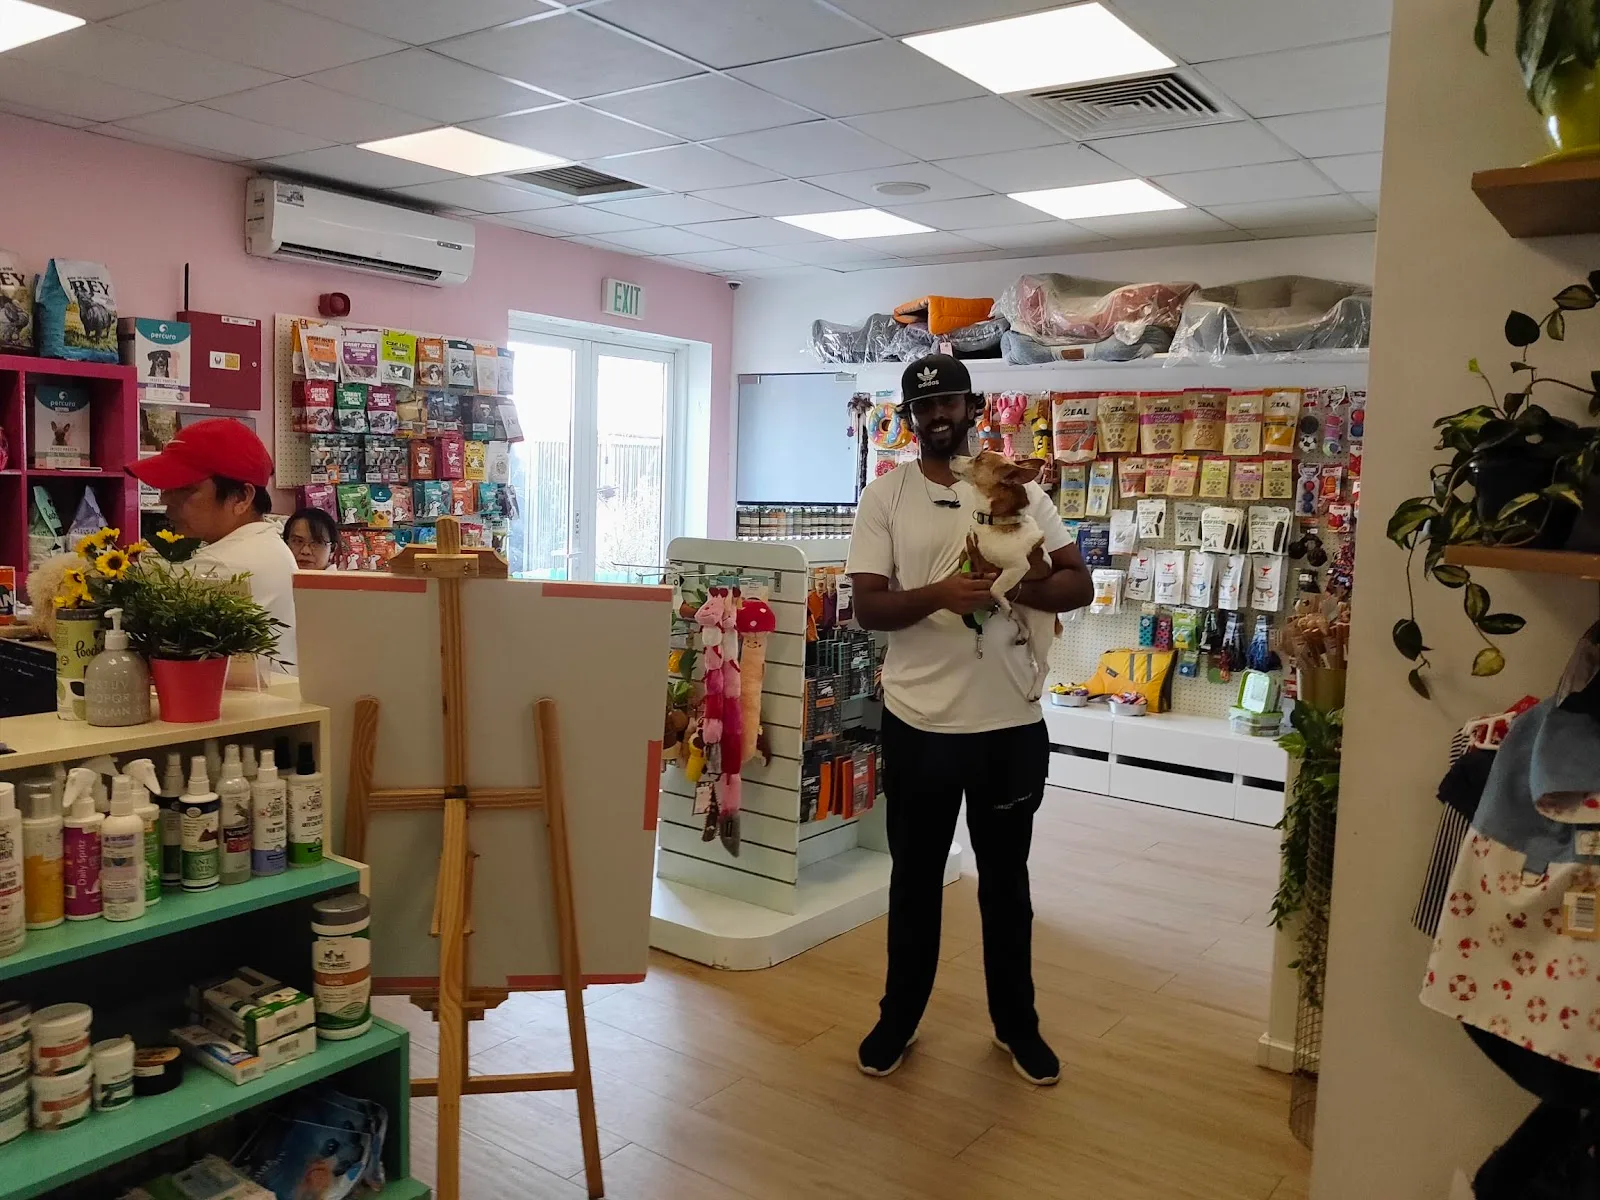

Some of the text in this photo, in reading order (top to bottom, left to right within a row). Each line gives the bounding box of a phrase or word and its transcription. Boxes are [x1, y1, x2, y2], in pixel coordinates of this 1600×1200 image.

[614, 282, 641, 315] EXIT
[150, 332, 176, 341] percuro
[918, 380, 939, 388] adidas
[1063, 407, 1089, 416] ZEAL
[77, 840, 88, 886] Daily Spritz
